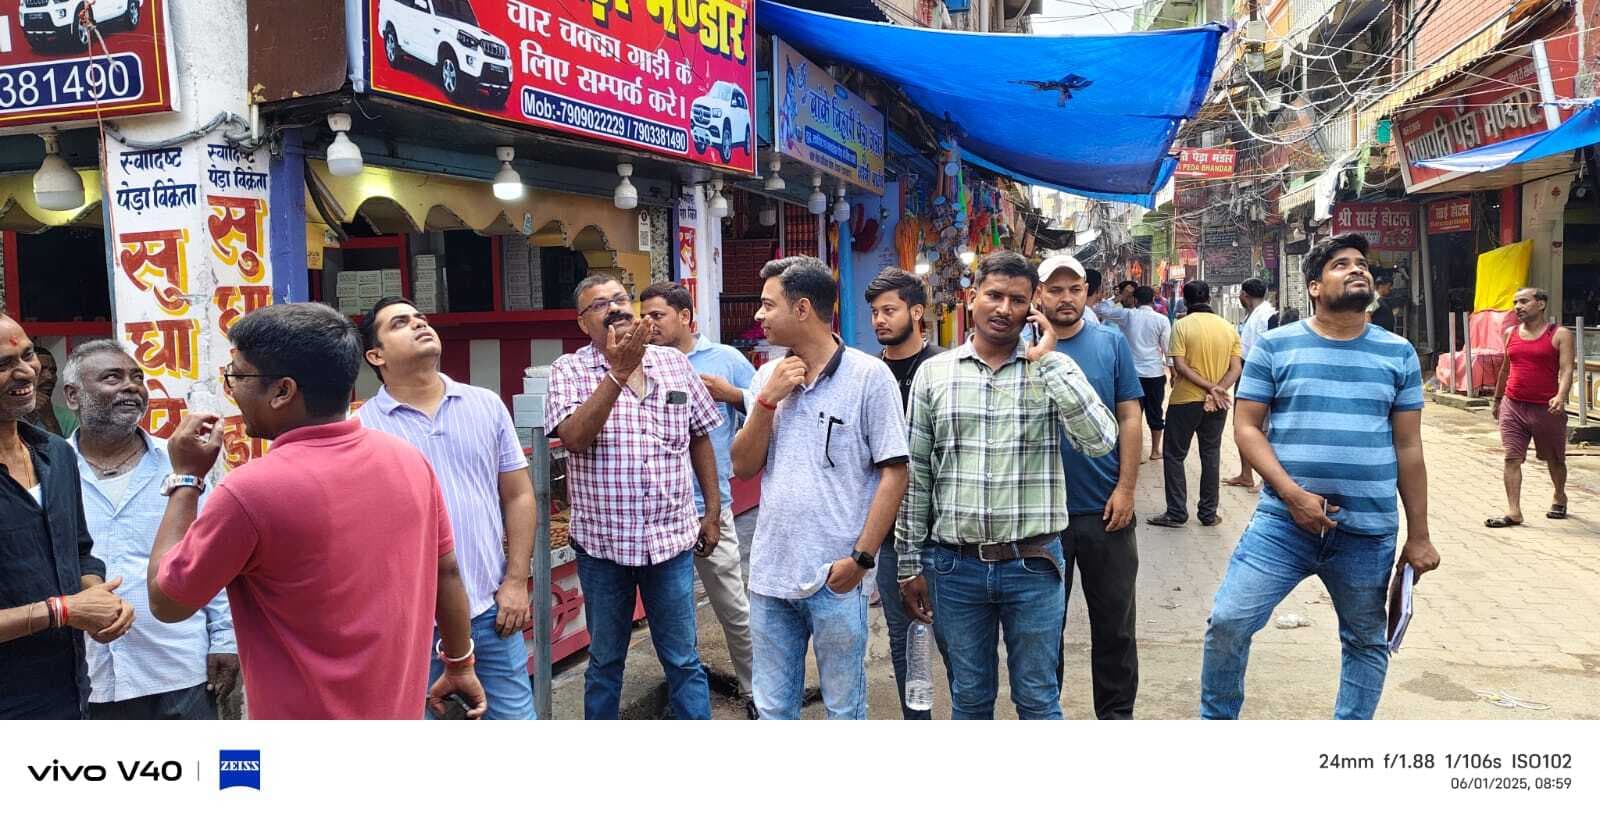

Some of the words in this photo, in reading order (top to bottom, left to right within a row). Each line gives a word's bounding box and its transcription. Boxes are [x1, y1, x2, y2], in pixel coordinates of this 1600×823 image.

[506, 1, 552, 37] चार
[557, 17, 621, 62] चक्का
[626, 43, 671, 81] गाड़ी
[519, 39, 570, 86] लिए
[576, 64, 643, 105] सम्पर्क
[524, 92, 624, 136] Mob:-7909022229
[633, 120, 686, 150] 7903381490
[116, 182, 151, 216] पेड़ा
[152, 178, 197, 209] विक्रेता
[208, 166, 231, 193] पेड़ा
[233, 165, 268, 192] विक्रेता
[1337, 206, 1353, 227] श्री
[1380, 207, 1411, 227] होटल
